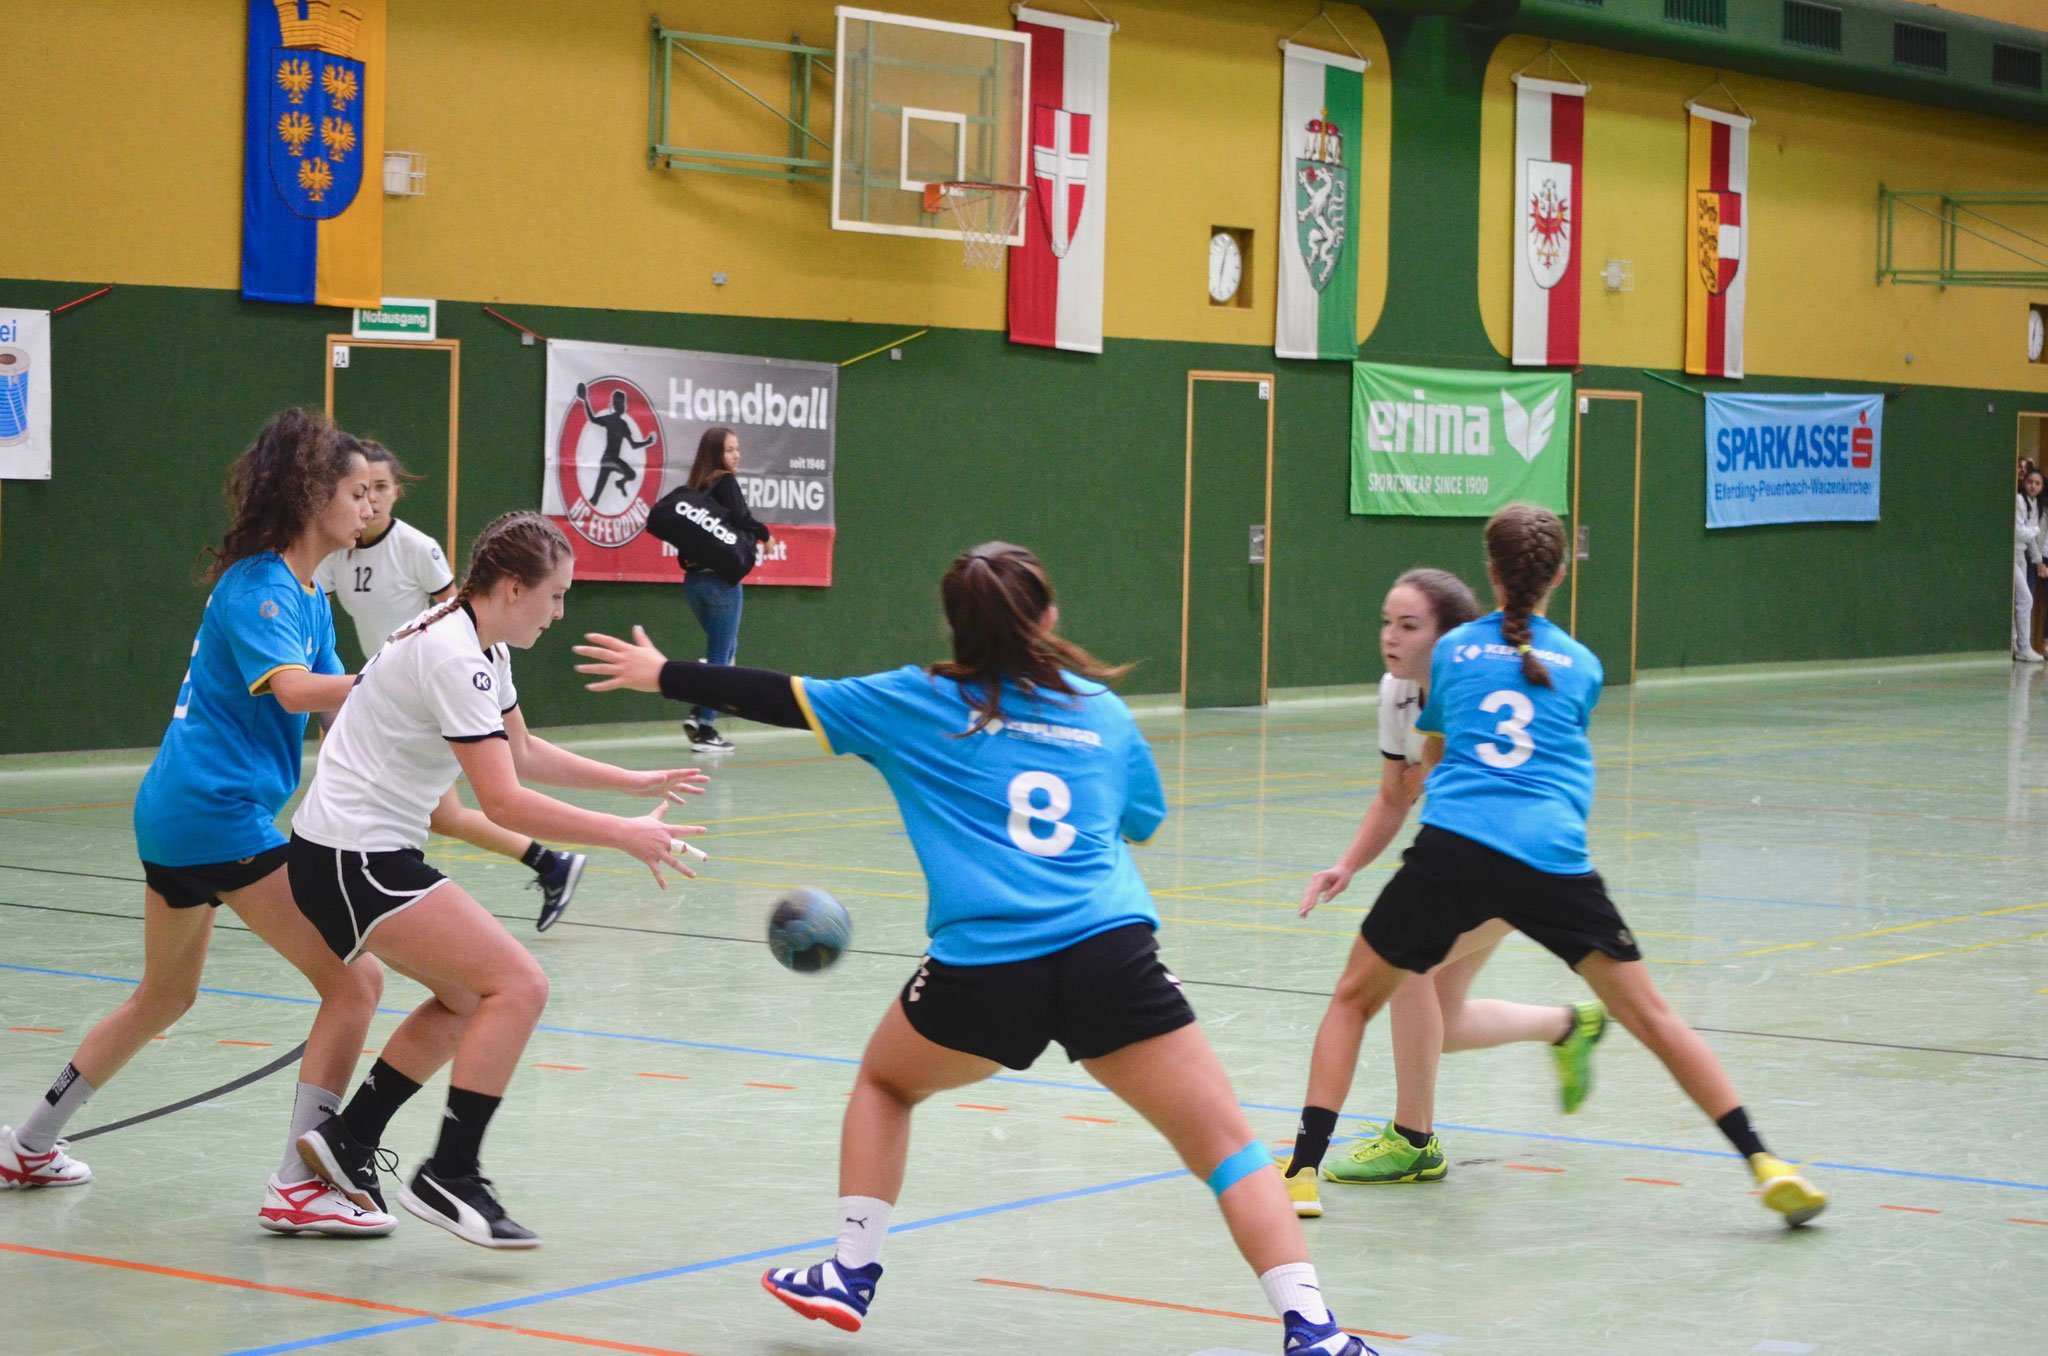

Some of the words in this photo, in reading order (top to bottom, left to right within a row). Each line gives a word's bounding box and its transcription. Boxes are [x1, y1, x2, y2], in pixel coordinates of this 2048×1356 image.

[361, 309, 427, 328] Notausgang
[668, 377, 828, 430] Handball
[1367, 389, 1490, 456] erima
[790, 456, 806, 469] seit
[807, 457, 826, 471] 1946
[1716, 424, 1849, 472] SPARKASSE
[1368, 472, 1431, 494] SPORTSWEAR
[1434, 475, 1462, 495] SINCE
[1466, 476, 1488, 495] 1900
[570, 497, 592, 528] HC
[588, 497, 652, 543] EFERDING
[675, 501, 738, 545] adidas
[354, 566, 373, 592] 12
[1474, 690, 1536, 769] 3
[1007, 770, 1078, 857] 8
